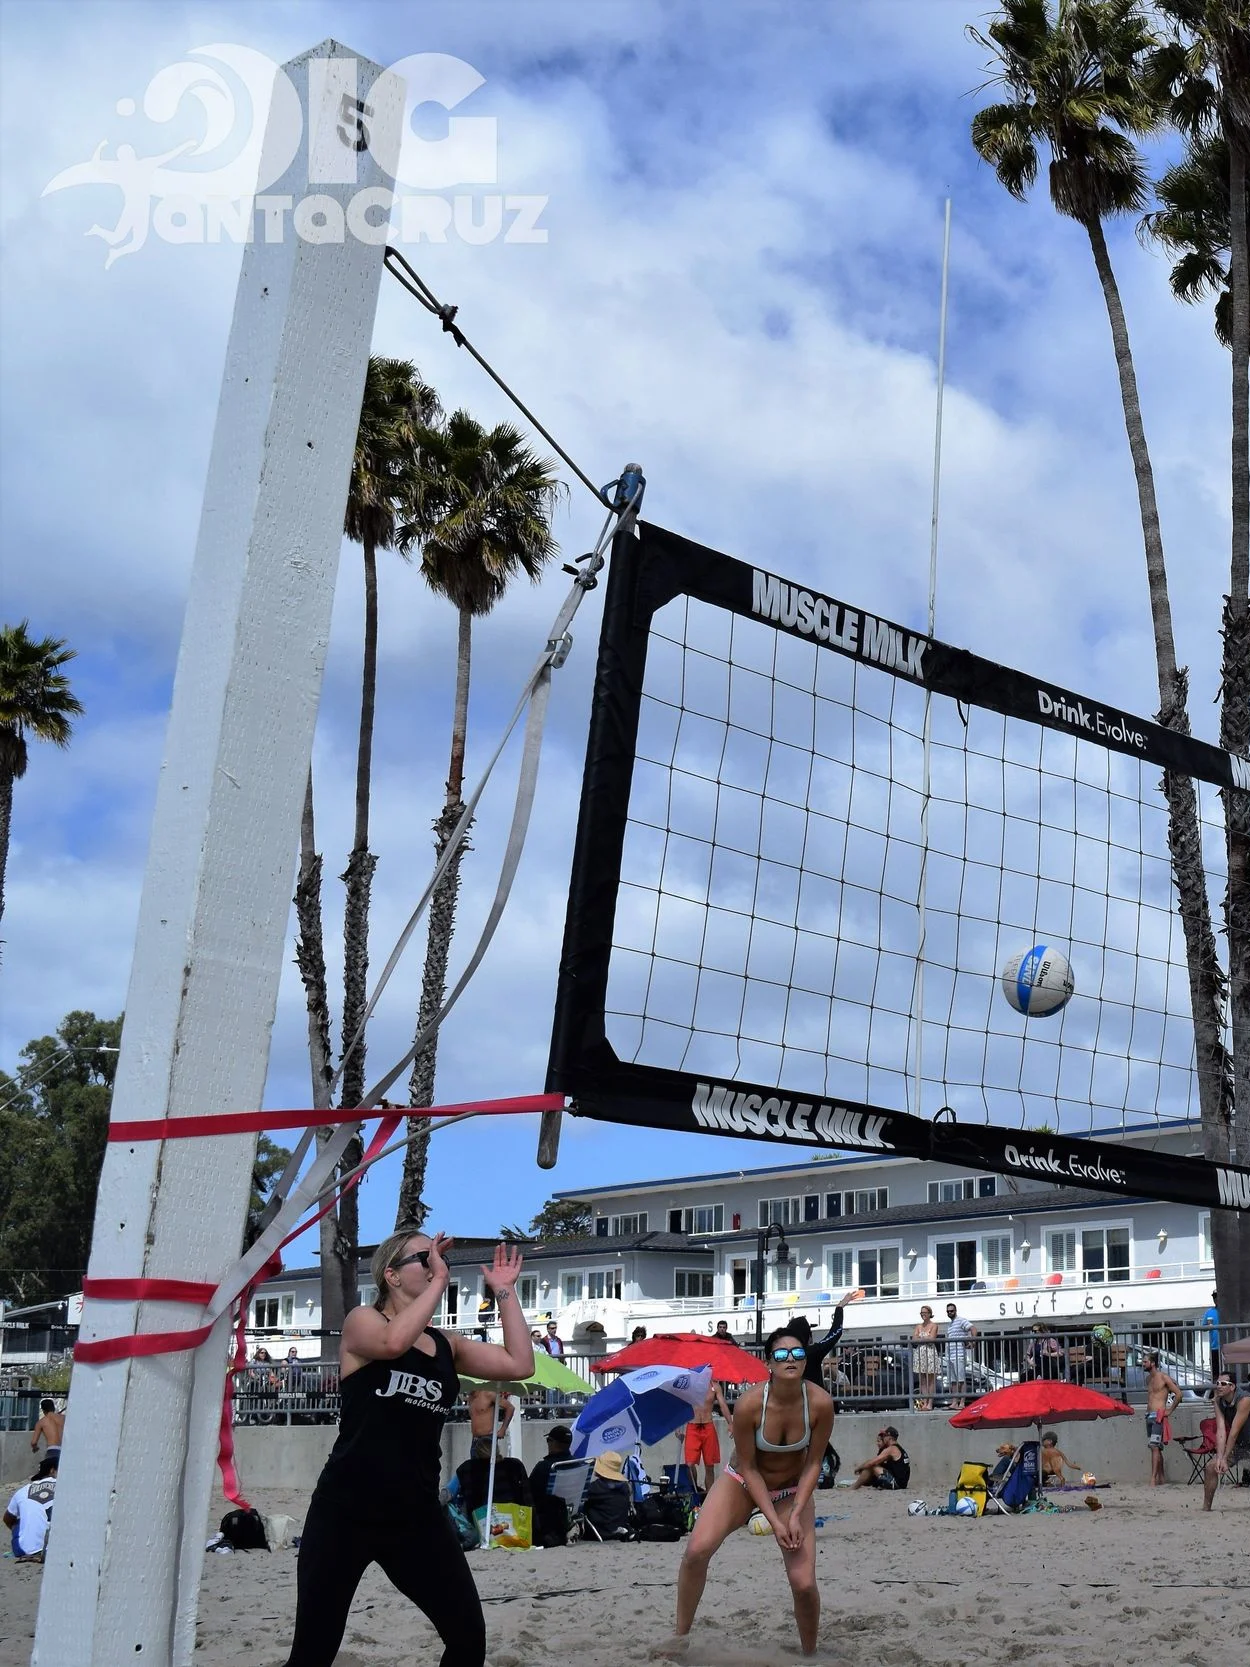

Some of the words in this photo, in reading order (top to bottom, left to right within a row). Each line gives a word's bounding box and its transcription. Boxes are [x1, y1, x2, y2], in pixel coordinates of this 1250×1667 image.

[335, 92, 375, 153] 5
[752, 569, 858, 652] MUSCLE
[862, 616, 925, 679] MILK
[691, 1083, 818, 1142] MUSCLE
[815, 1106, 896, 1149] MILK
[707, 1314, 766, 1333] sint
[999, 1291, 1057, 1316] surf
[1085, 1295, 1125, 1310] co.
